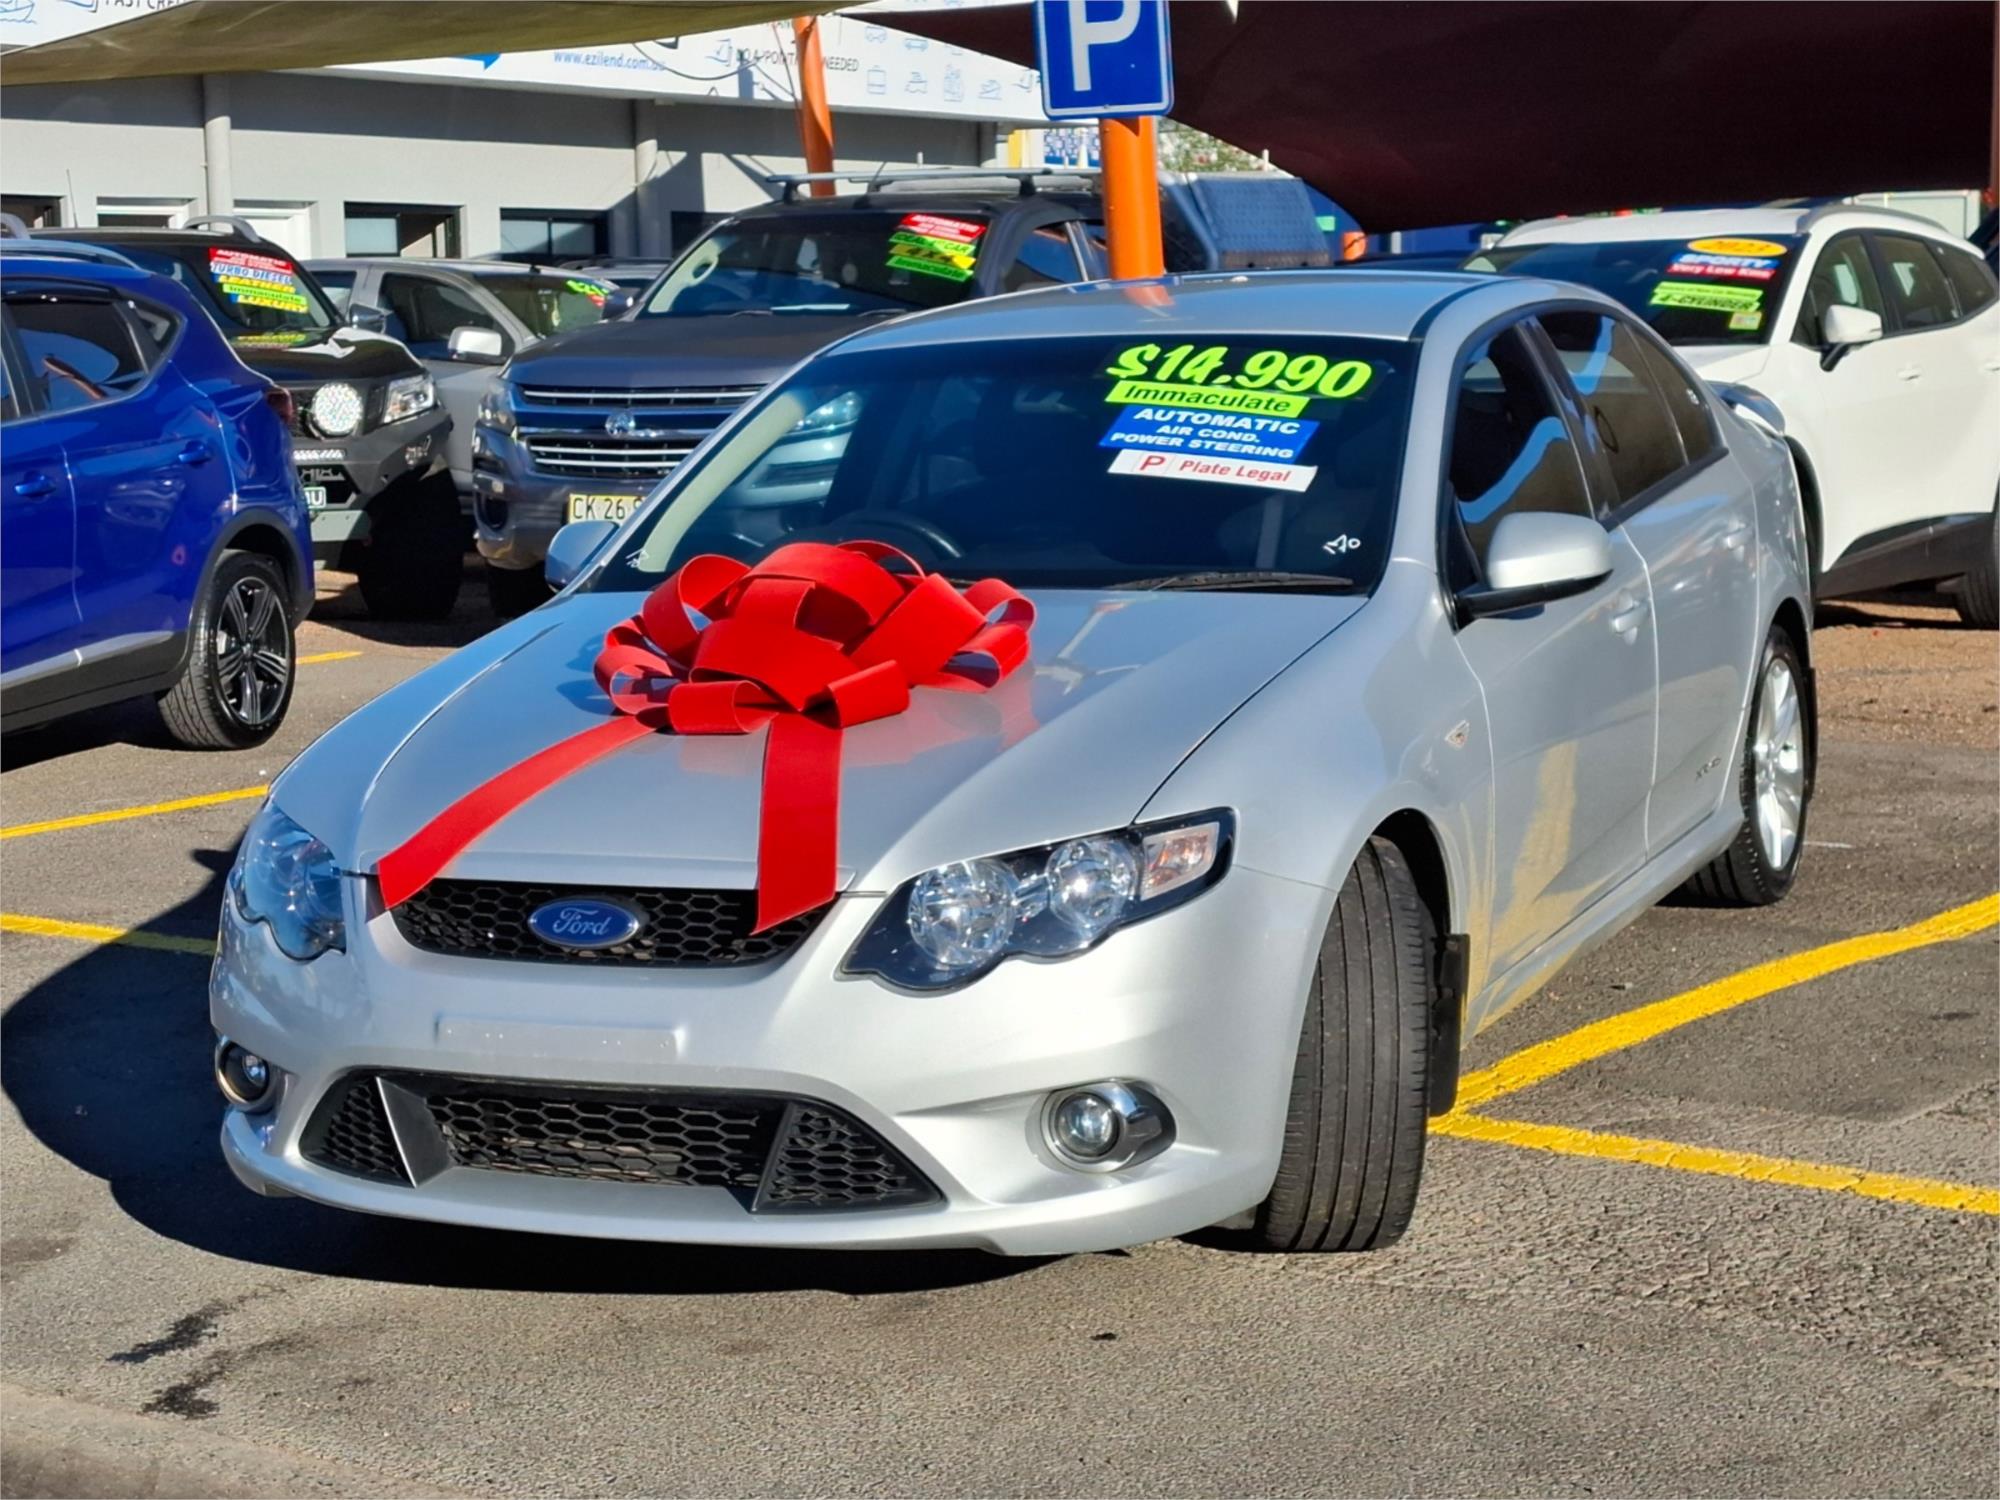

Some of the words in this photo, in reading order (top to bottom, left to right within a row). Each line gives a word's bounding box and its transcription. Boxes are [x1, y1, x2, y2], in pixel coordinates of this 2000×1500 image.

[1068, 0, 1142, 92] P
[1672, 263, 1705, 275] Very
[1706, 265, 1736, 275] Low
[1679, 254, 1772, 268] SPORTY
[211, 262, 249, 275] TURBO
[252, 270, 293, 284] DIESEL
[219, 275, 295, 293] LEATHER
[238, 295, 308, 313] LUXURY
[1124, 385, 1291, 413] Immaculate
[1134, 407, 1300, 434] AUTOMATIC
[1110, 432, 1184, 448] POWER
[1188, 437, 1294, 459] STEERING
[1156, 425, 1194, 437] AIR
[1197, 427, 1261, 443] COND.
[1139, 455, 1166, 471] P
[1179, 460, 1231, 476] Plate
[1236, 465, 1293, 482] Legal
[573, 497, 596, 519] CK
[604, 497, 626, 520] 26
[552, 907, 612, 935] Ford
